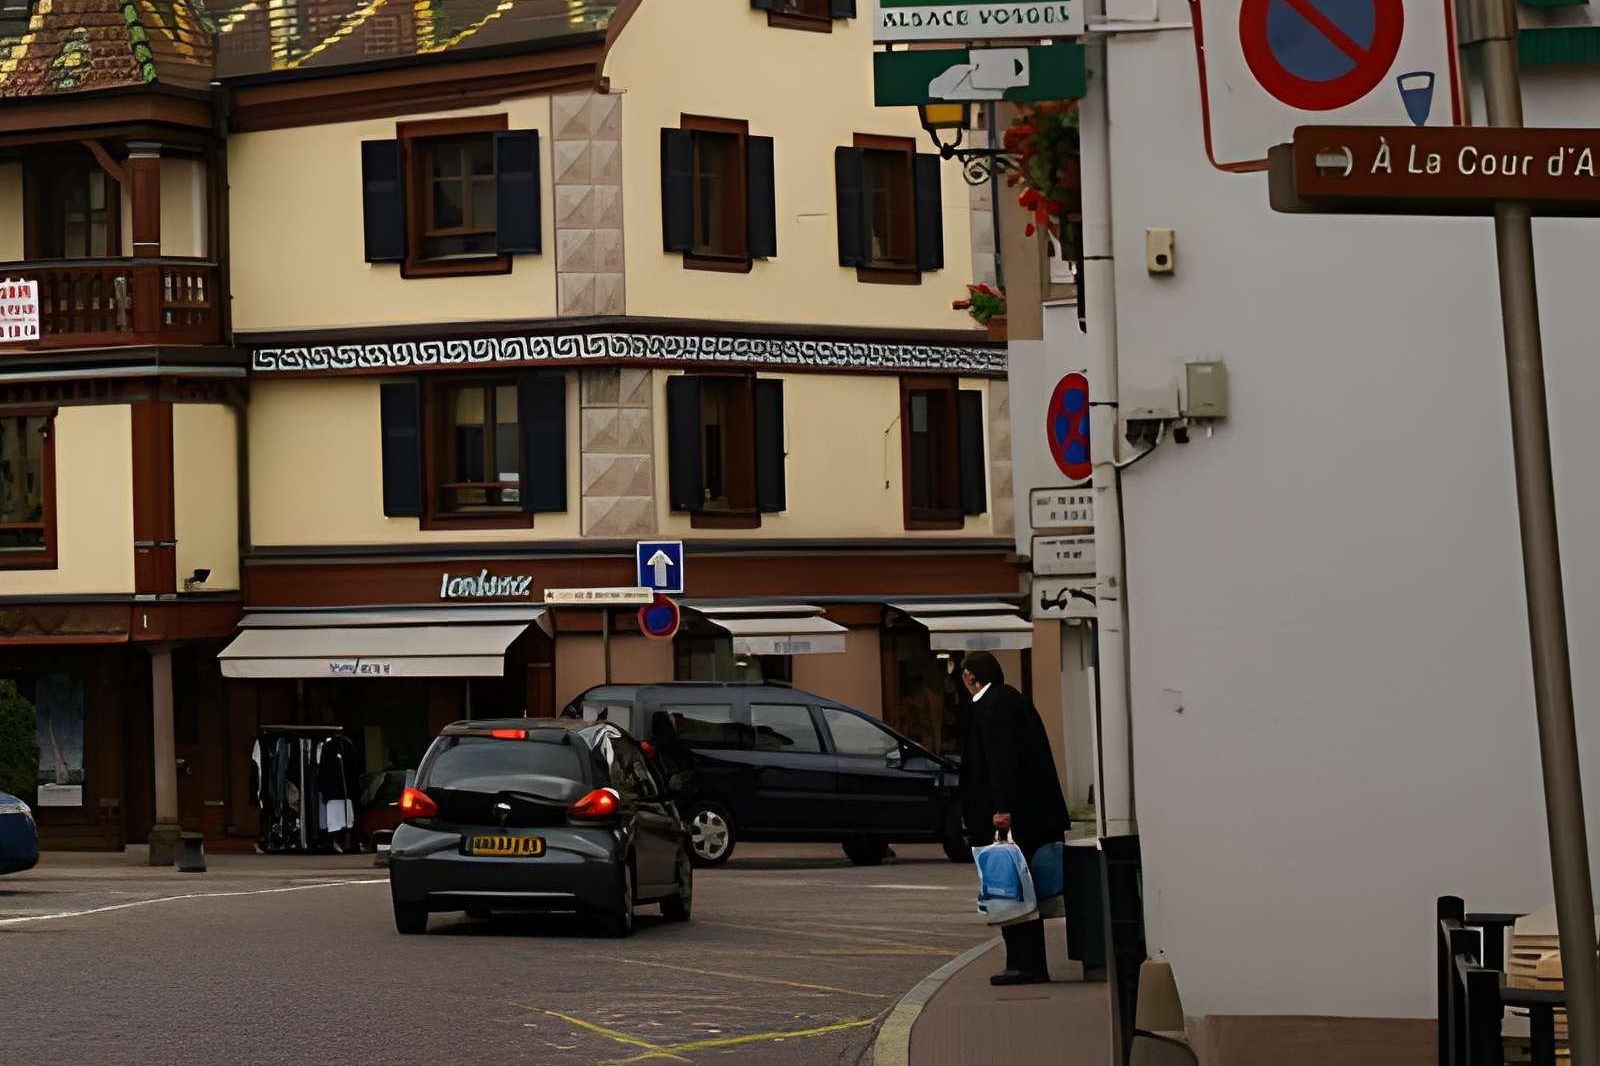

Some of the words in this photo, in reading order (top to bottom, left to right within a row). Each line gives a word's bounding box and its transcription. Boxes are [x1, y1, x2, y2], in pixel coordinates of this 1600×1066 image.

[1370, 136, 1392, 174] À
[1408, 144, 1441, 174] La
[1458, 145, 1534, 176] Cour
